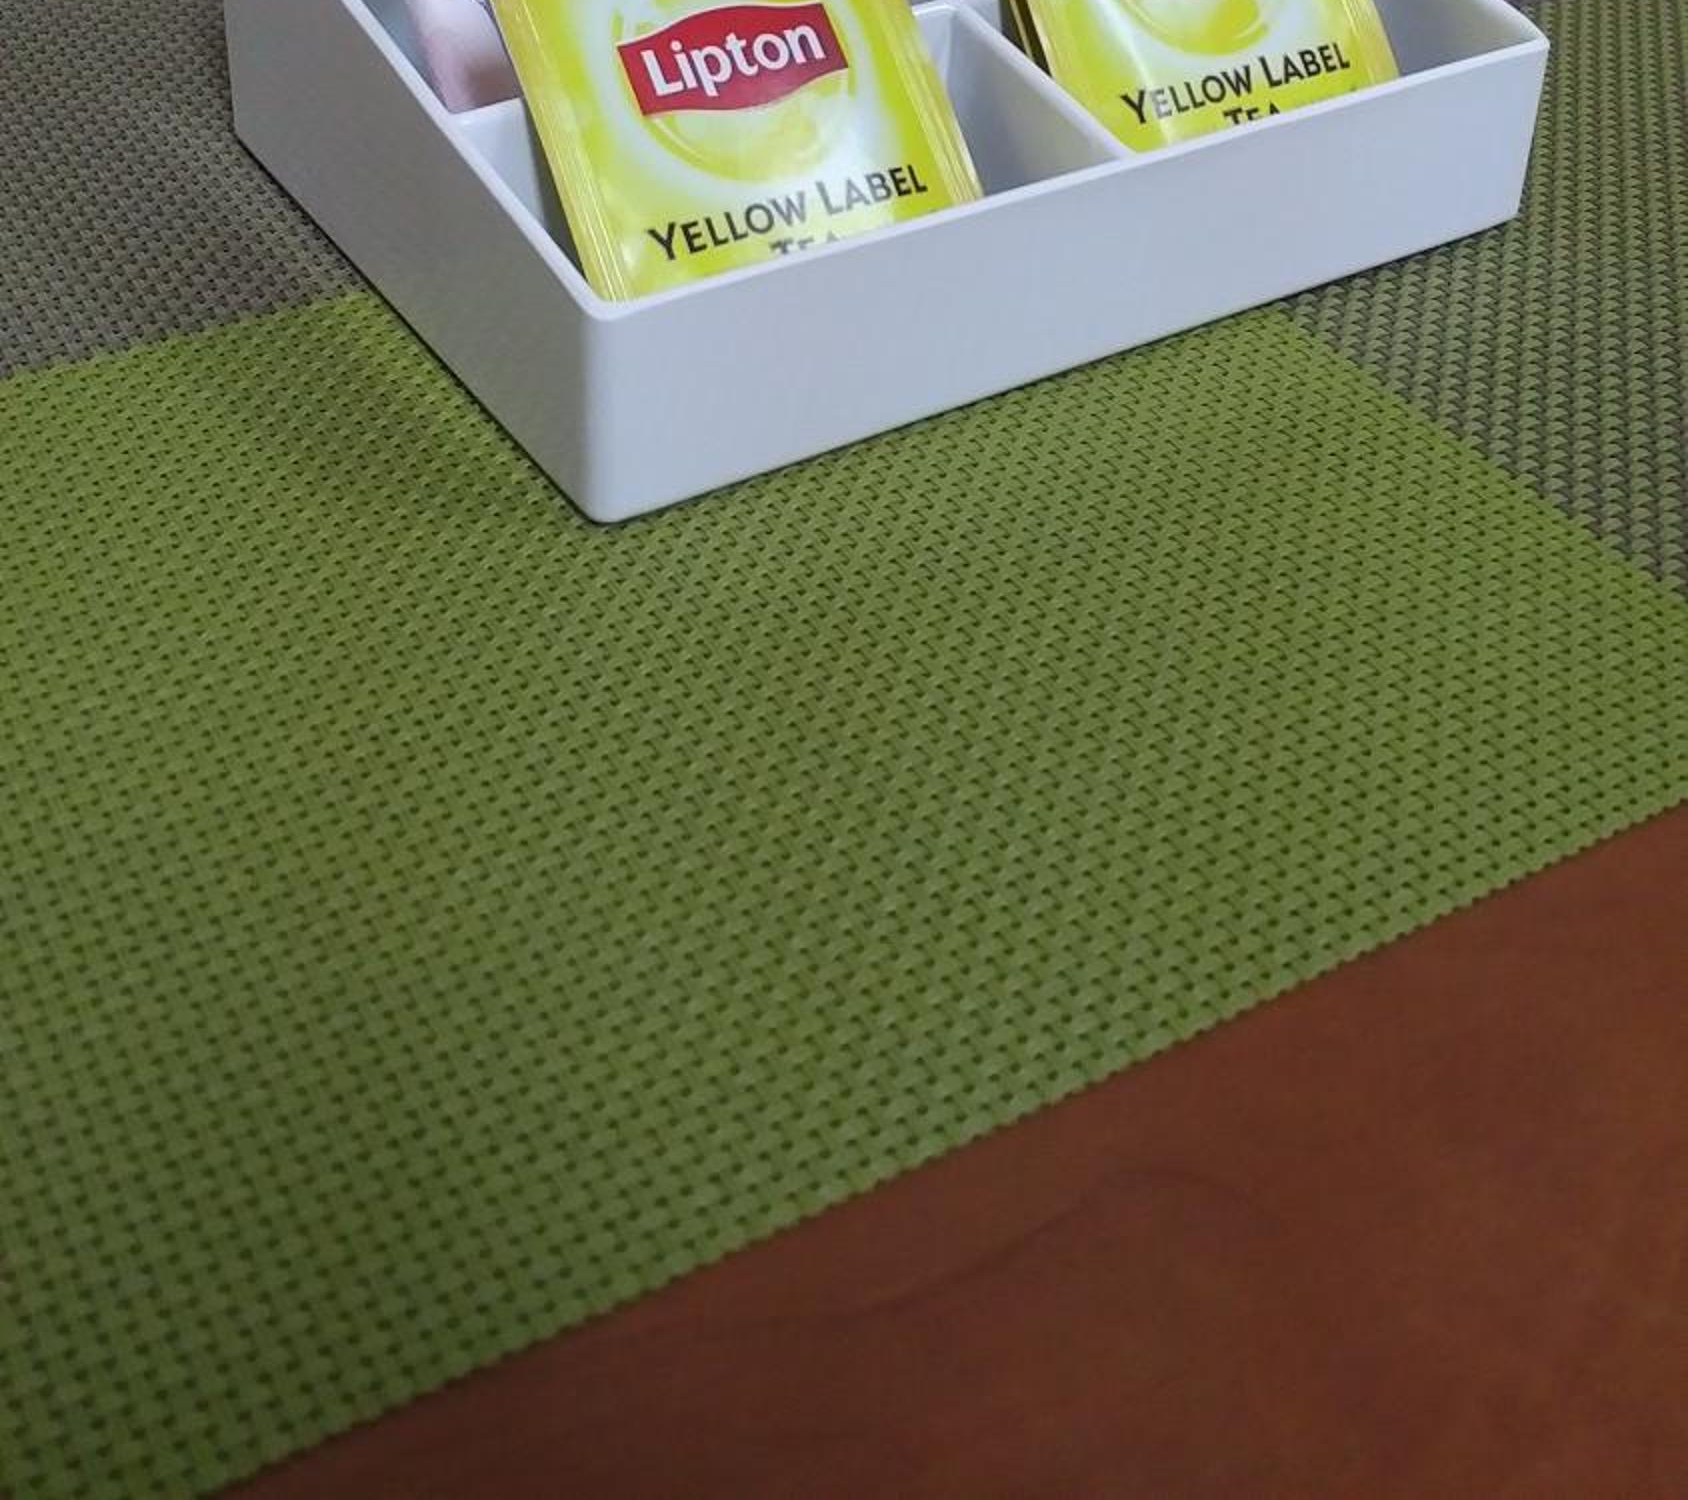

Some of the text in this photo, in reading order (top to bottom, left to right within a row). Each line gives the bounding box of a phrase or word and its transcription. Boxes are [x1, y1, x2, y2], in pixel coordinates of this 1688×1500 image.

[640, 24, 826, 97] Lipton
[1120, 41, 1351, 125] YELLOW LABEL
[647, 190, 806, 261] YELLOW
[815, 164, 928, 215] LABEL
